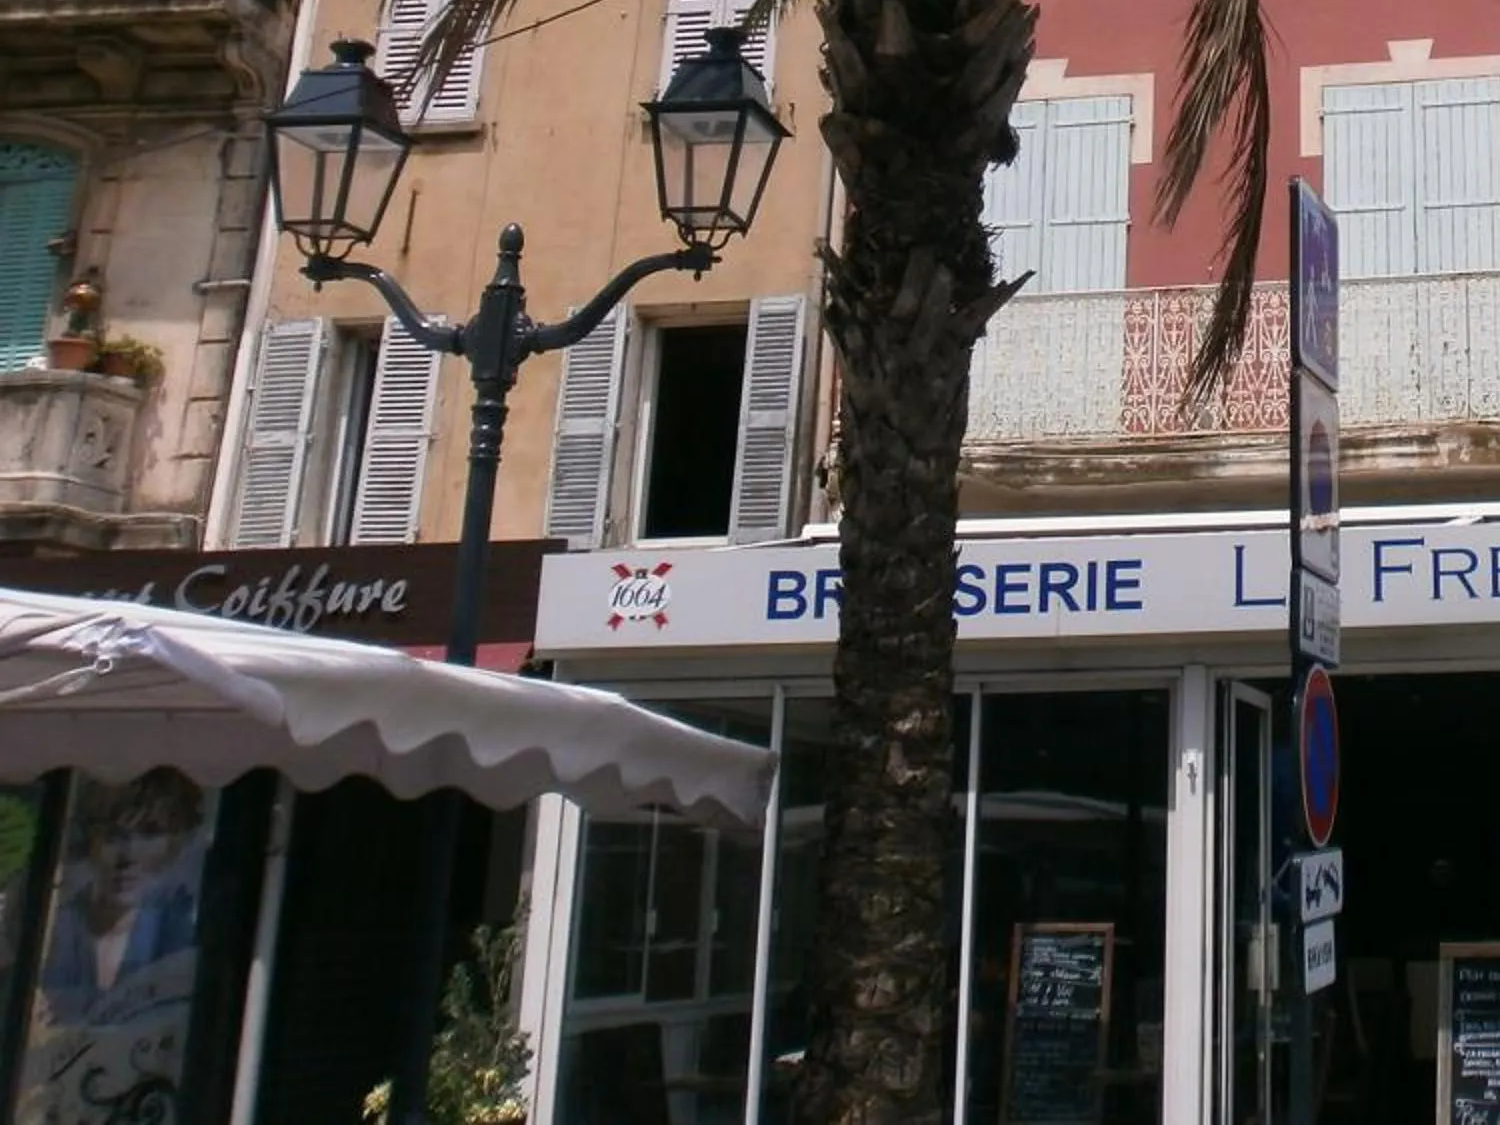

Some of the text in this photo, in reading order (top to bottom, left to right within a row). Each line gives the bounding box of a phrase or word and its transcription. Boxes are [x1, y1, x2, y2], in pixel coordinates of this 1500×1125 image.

[174, 563, 407, 633] Coiffure
[612, 581, 667, 608] 1664
[766, 559, 1143, 619] BRSERIE
[1233, 544, 1292, 607] L
